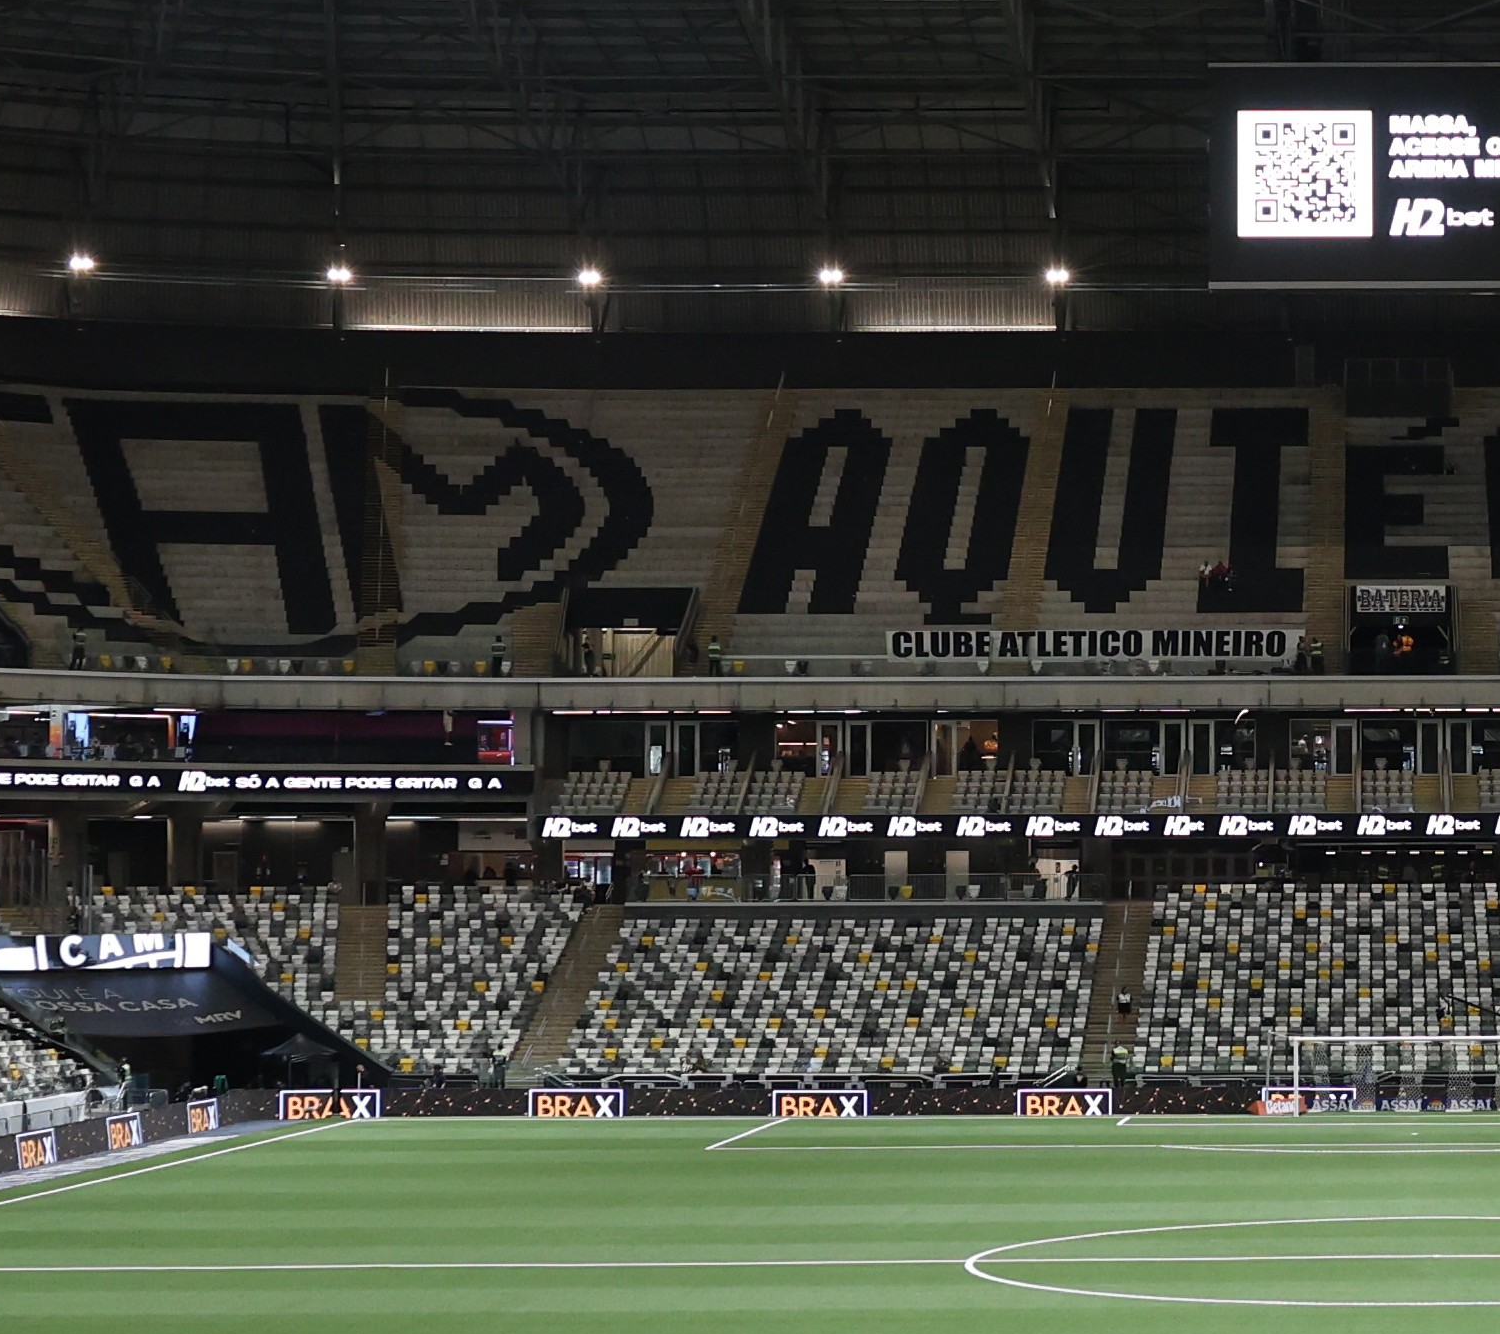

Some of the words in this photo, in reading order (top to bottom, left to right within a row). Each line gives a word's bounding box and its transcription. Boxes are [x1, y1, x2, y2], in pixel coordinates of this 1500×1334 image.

[1388, 114, 1477, 136] MASSA,
[1388, 136, 1481, 156] ACESSE
[1388, 159, 1469, 178] ARENA
[737, 408, 1310, 624] AQUI
[1358, 589, 1444, 610] BATERIA
[891, 630, 991, 658] CLUBE
[1152, 629, 1286, 658] MINEIRO
[14, 773, 59, 786] PODE
[61, 775, 120, 787] GRITAR
[265, 778, 280, 789] A
[283, 778, 342, 789] GENTE
[344, 778, 392, 789] PODE
[394, 778, 458, 789] GRITAR
[537, 1094, 615, 1117] BRAX
[781, 1094, 859, 1117] BRAX
[1026, 1093, 1104, 1116] BRAX
[110, 1119, 141, 1151] BRAX
[21, 1136, 56, 1168] BRAX
